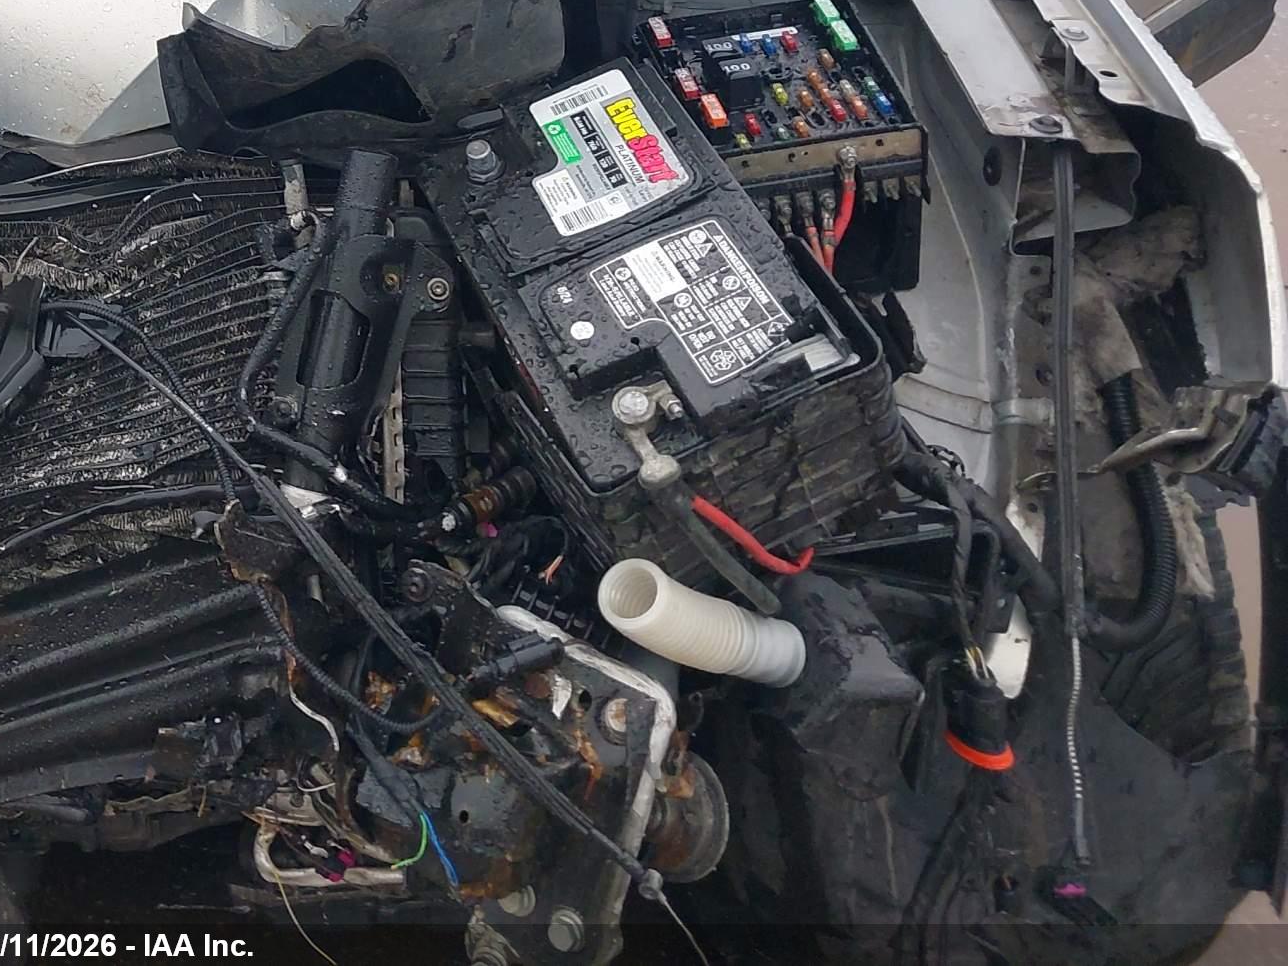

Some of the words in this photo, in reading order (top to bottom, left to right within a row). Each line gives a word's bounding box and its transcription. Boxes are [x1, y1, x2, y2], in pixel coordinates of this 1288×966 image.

[706, 42, 733, 51] 100
[724, 63, 751, 72] 100
[604, 97, 679, 184] EverStart
[616, 145, 645, 184] PLATINUM
